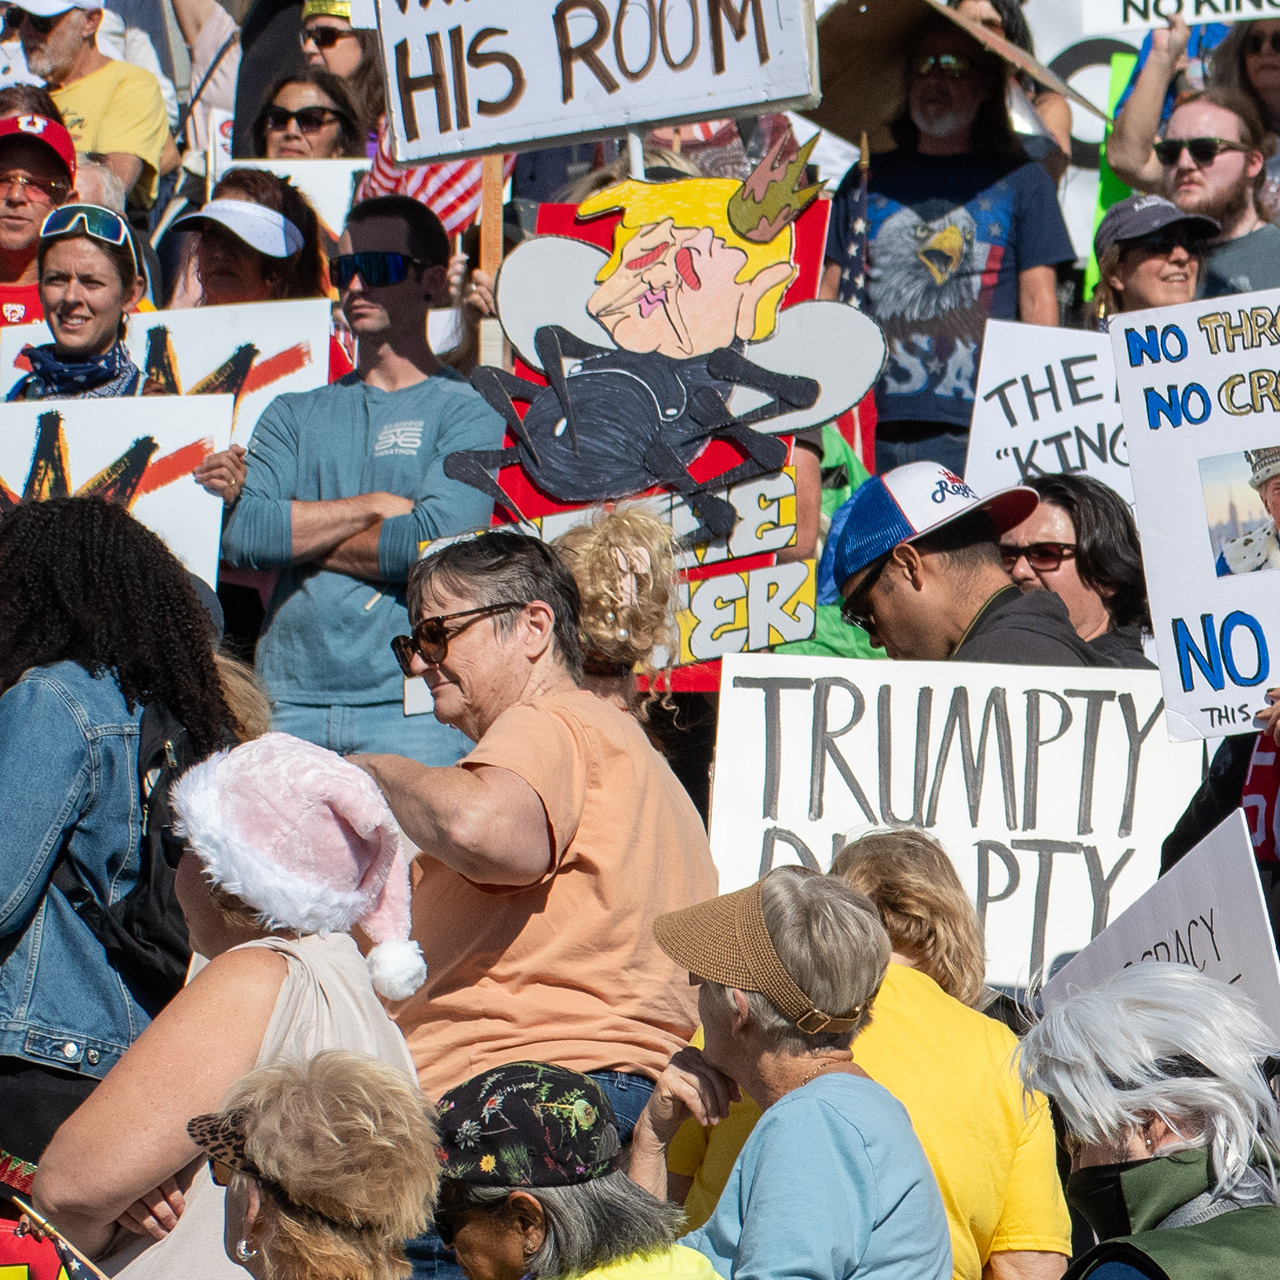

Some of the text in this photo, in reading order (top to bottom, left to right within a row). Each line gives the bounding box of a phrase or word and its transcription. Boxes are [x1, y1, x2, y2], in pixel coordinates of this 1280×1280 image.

[394, 0, 770, 142] HIS ROOM
[1124, 324, 1188, 367] NO
[983, 354, 1104, 428] THE
[1143, 382, 1211, 429] NO
[1171, 610, 1271, 692] NO
[1201, 704, 1252, 728] THIS
[733, 676, 1165, 838] TRUMPTY
